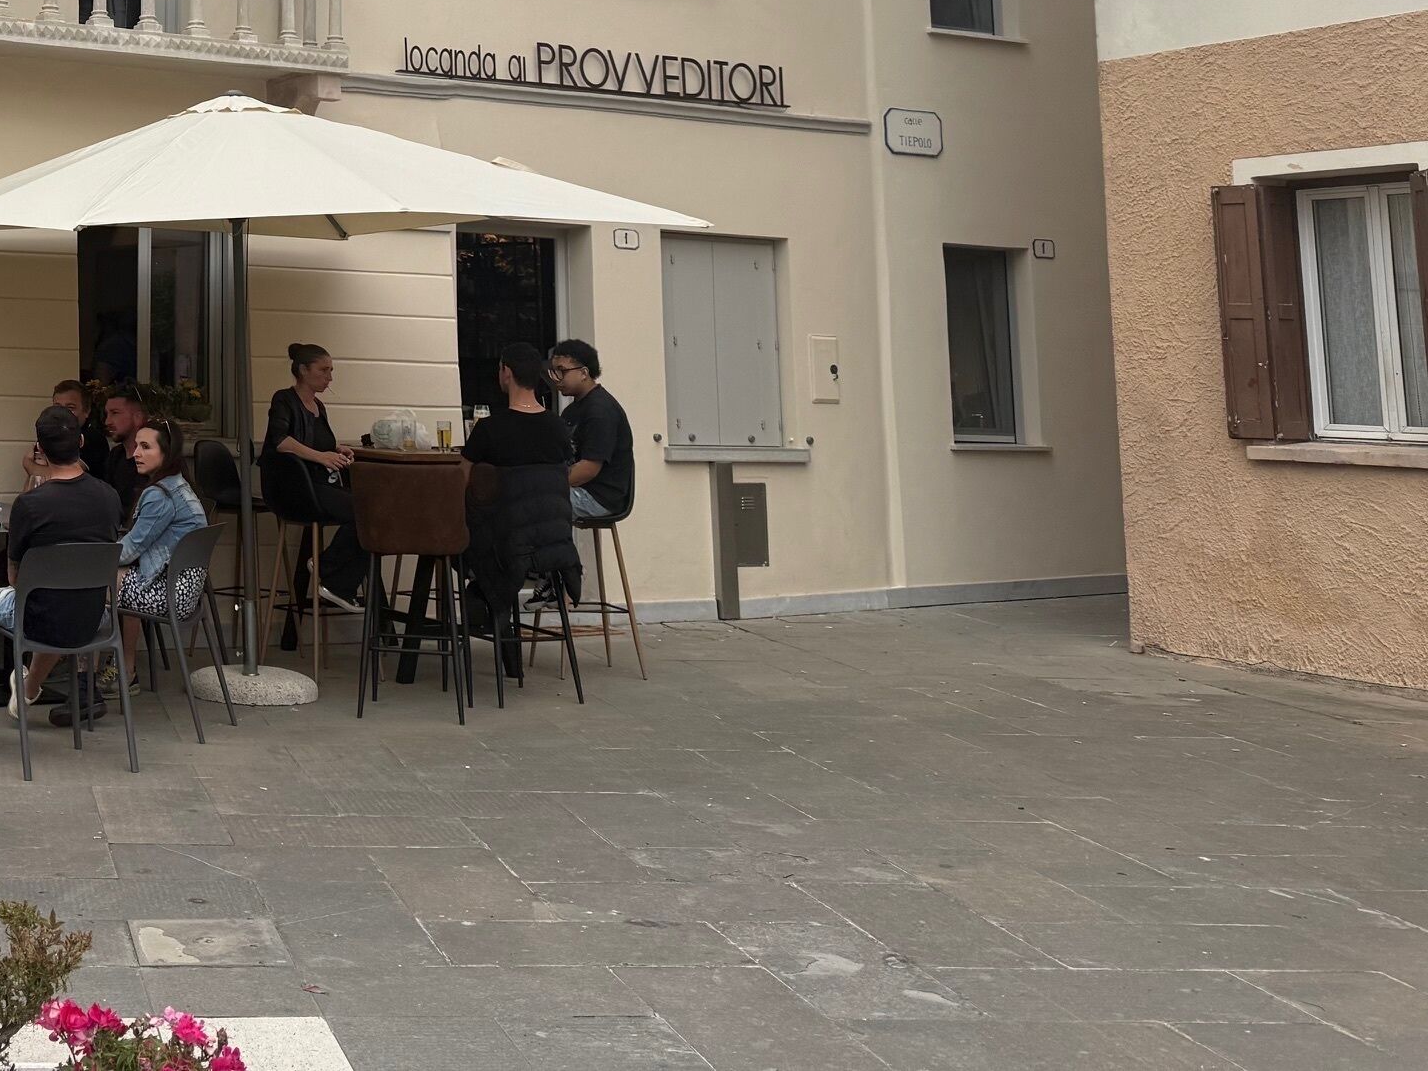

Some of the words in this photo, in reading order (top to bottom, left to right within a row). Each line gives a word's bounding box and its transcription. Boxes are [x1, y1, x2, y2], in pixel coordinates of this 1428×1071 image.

[403, 37, 496, 81] locanda
[508, 54, 527, 83] ai
[535, 41, 785, 107] PROVVEDITORI
[898, 135, 932, 149] TIEPOLO
